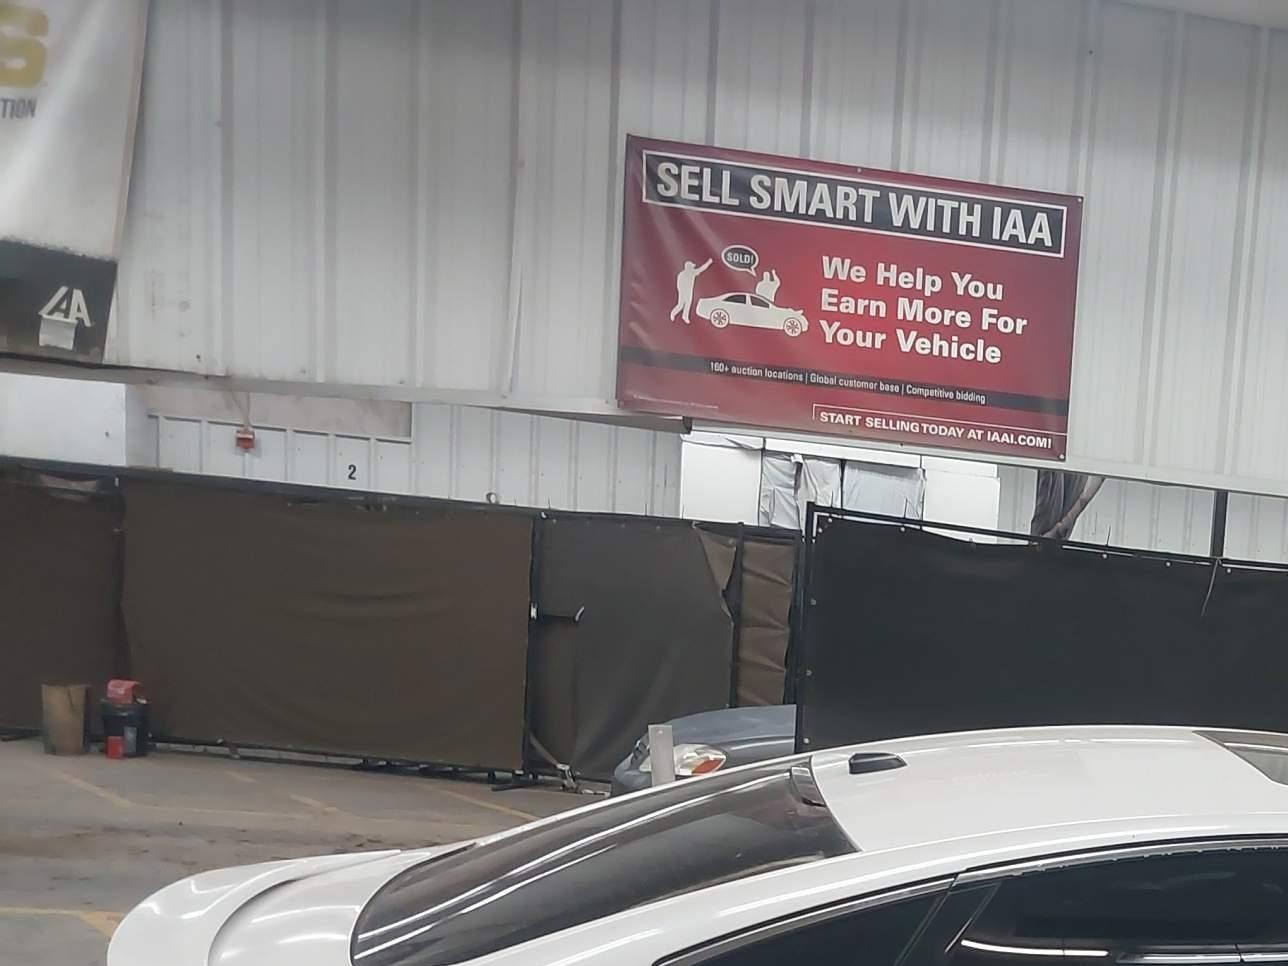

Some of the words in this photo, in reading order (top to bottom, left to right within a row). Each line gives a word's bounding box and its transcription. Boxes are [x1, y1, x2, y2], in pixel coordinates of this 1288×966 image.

[657, 162, 740, 206] SELL
[750, 174, 880, 223] SMART
[889, 192, 982, 237] WITH
[992, 207, 1053, 247] IAA
[726, 251, 754, 264] SOLD!
[822, 255, 866, 282] We
[876, 262, 942, 296] Help
[951, 272, 1003, 300] You
[821, 288, 887, 318] Earn
[897, 297, 971, 328] More
[981, 308, 1028, 335] For
[819, 319, 887, 349] Your
[895, 328, 1001, 363] Vehicle
[731, 366, 762, 377] auction
[764, 368, 803, 382] locations
[810, 373, 837, 385] Global
[838, 378, 878, 390] customer
[880, 380, 899, 393] base
[906, 384, 954, 400] Competitive
[956, 390, 986, 405] bidding
[820, 411, 862, 426] START
[865, 417, 920, 433] SELLING
[922, 422, 964, 439] TODAY
[967, 429, 984, 441] AT
[987, 431, 1052, 449] IAAI.COM!
[347, 464, 357, 481] 2
